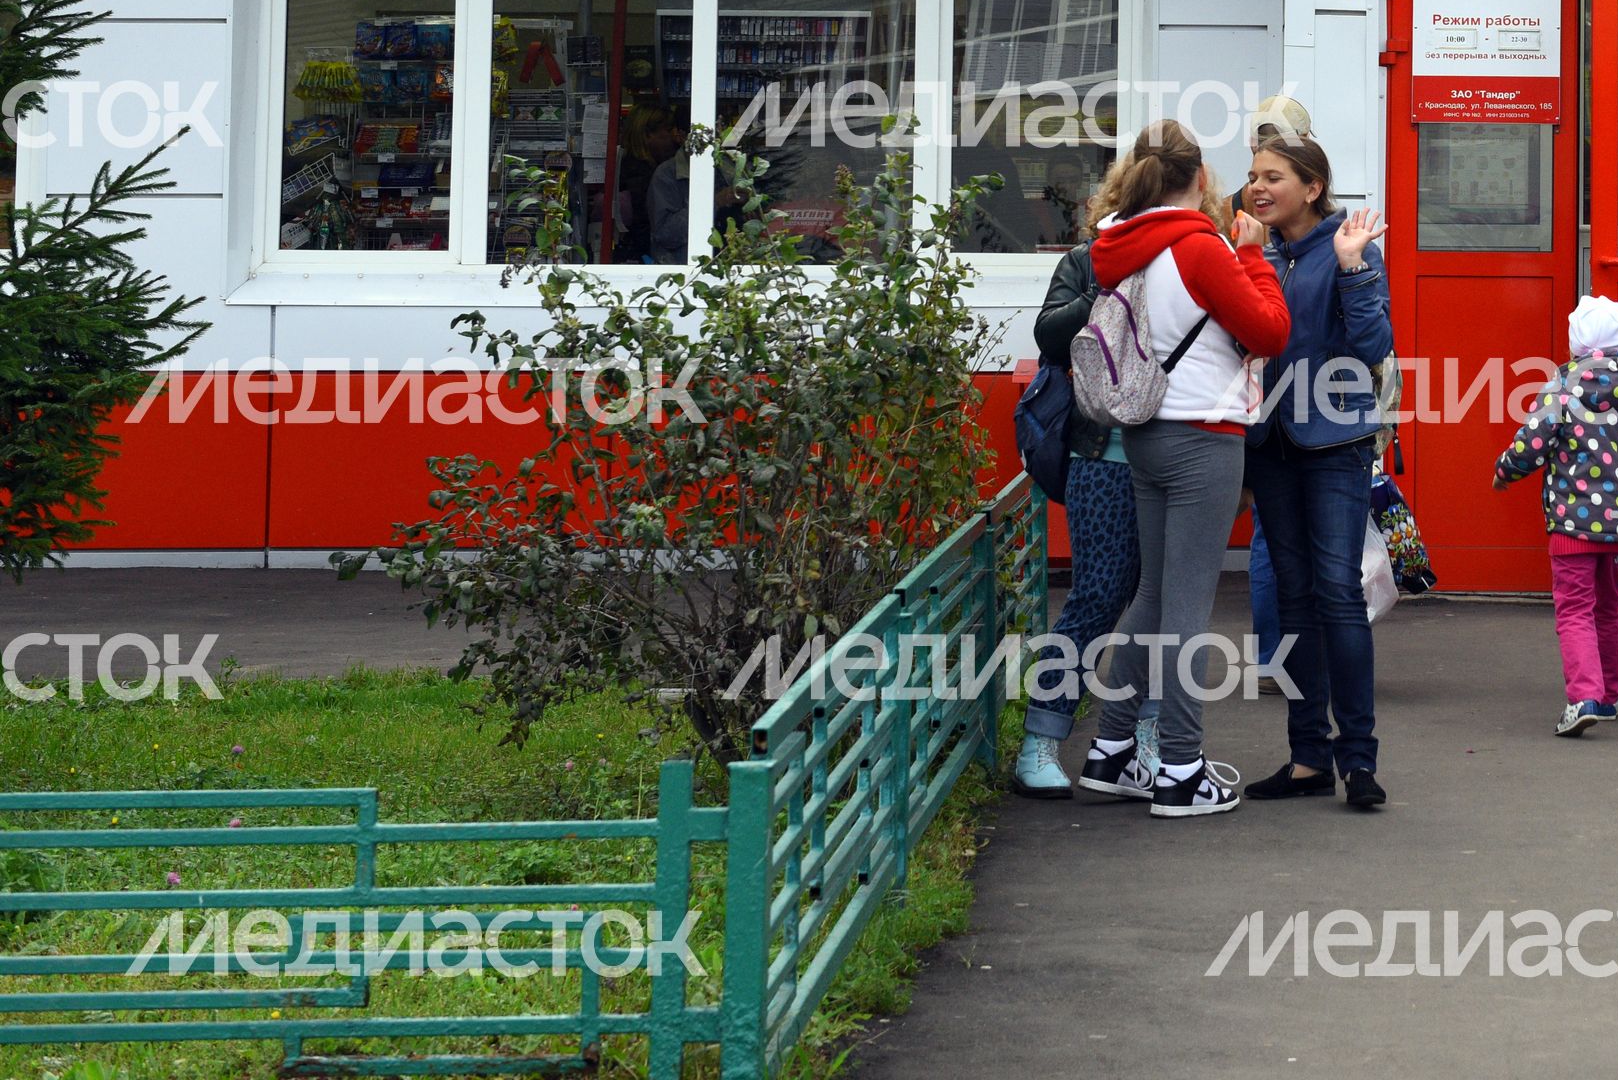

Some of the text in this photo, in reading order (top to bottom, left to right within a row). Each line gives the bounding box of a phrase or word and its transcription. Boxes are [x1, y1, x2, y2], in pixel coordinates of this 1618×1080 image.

[1432, 14, 1541, 28] Режим работы
[1446, 35, 1465, 43] 10:00
[1425, 51, 1441, 60] без
[1443, 53, 1488, 61] перерыва
[1499, 53, 1547, 61] выходных
[1451, 90, 1473, 98] ЗАО
[1425, 102, 1468, 110] Краснодар,
[1484, 102, 1537, 110] Леваневского,
